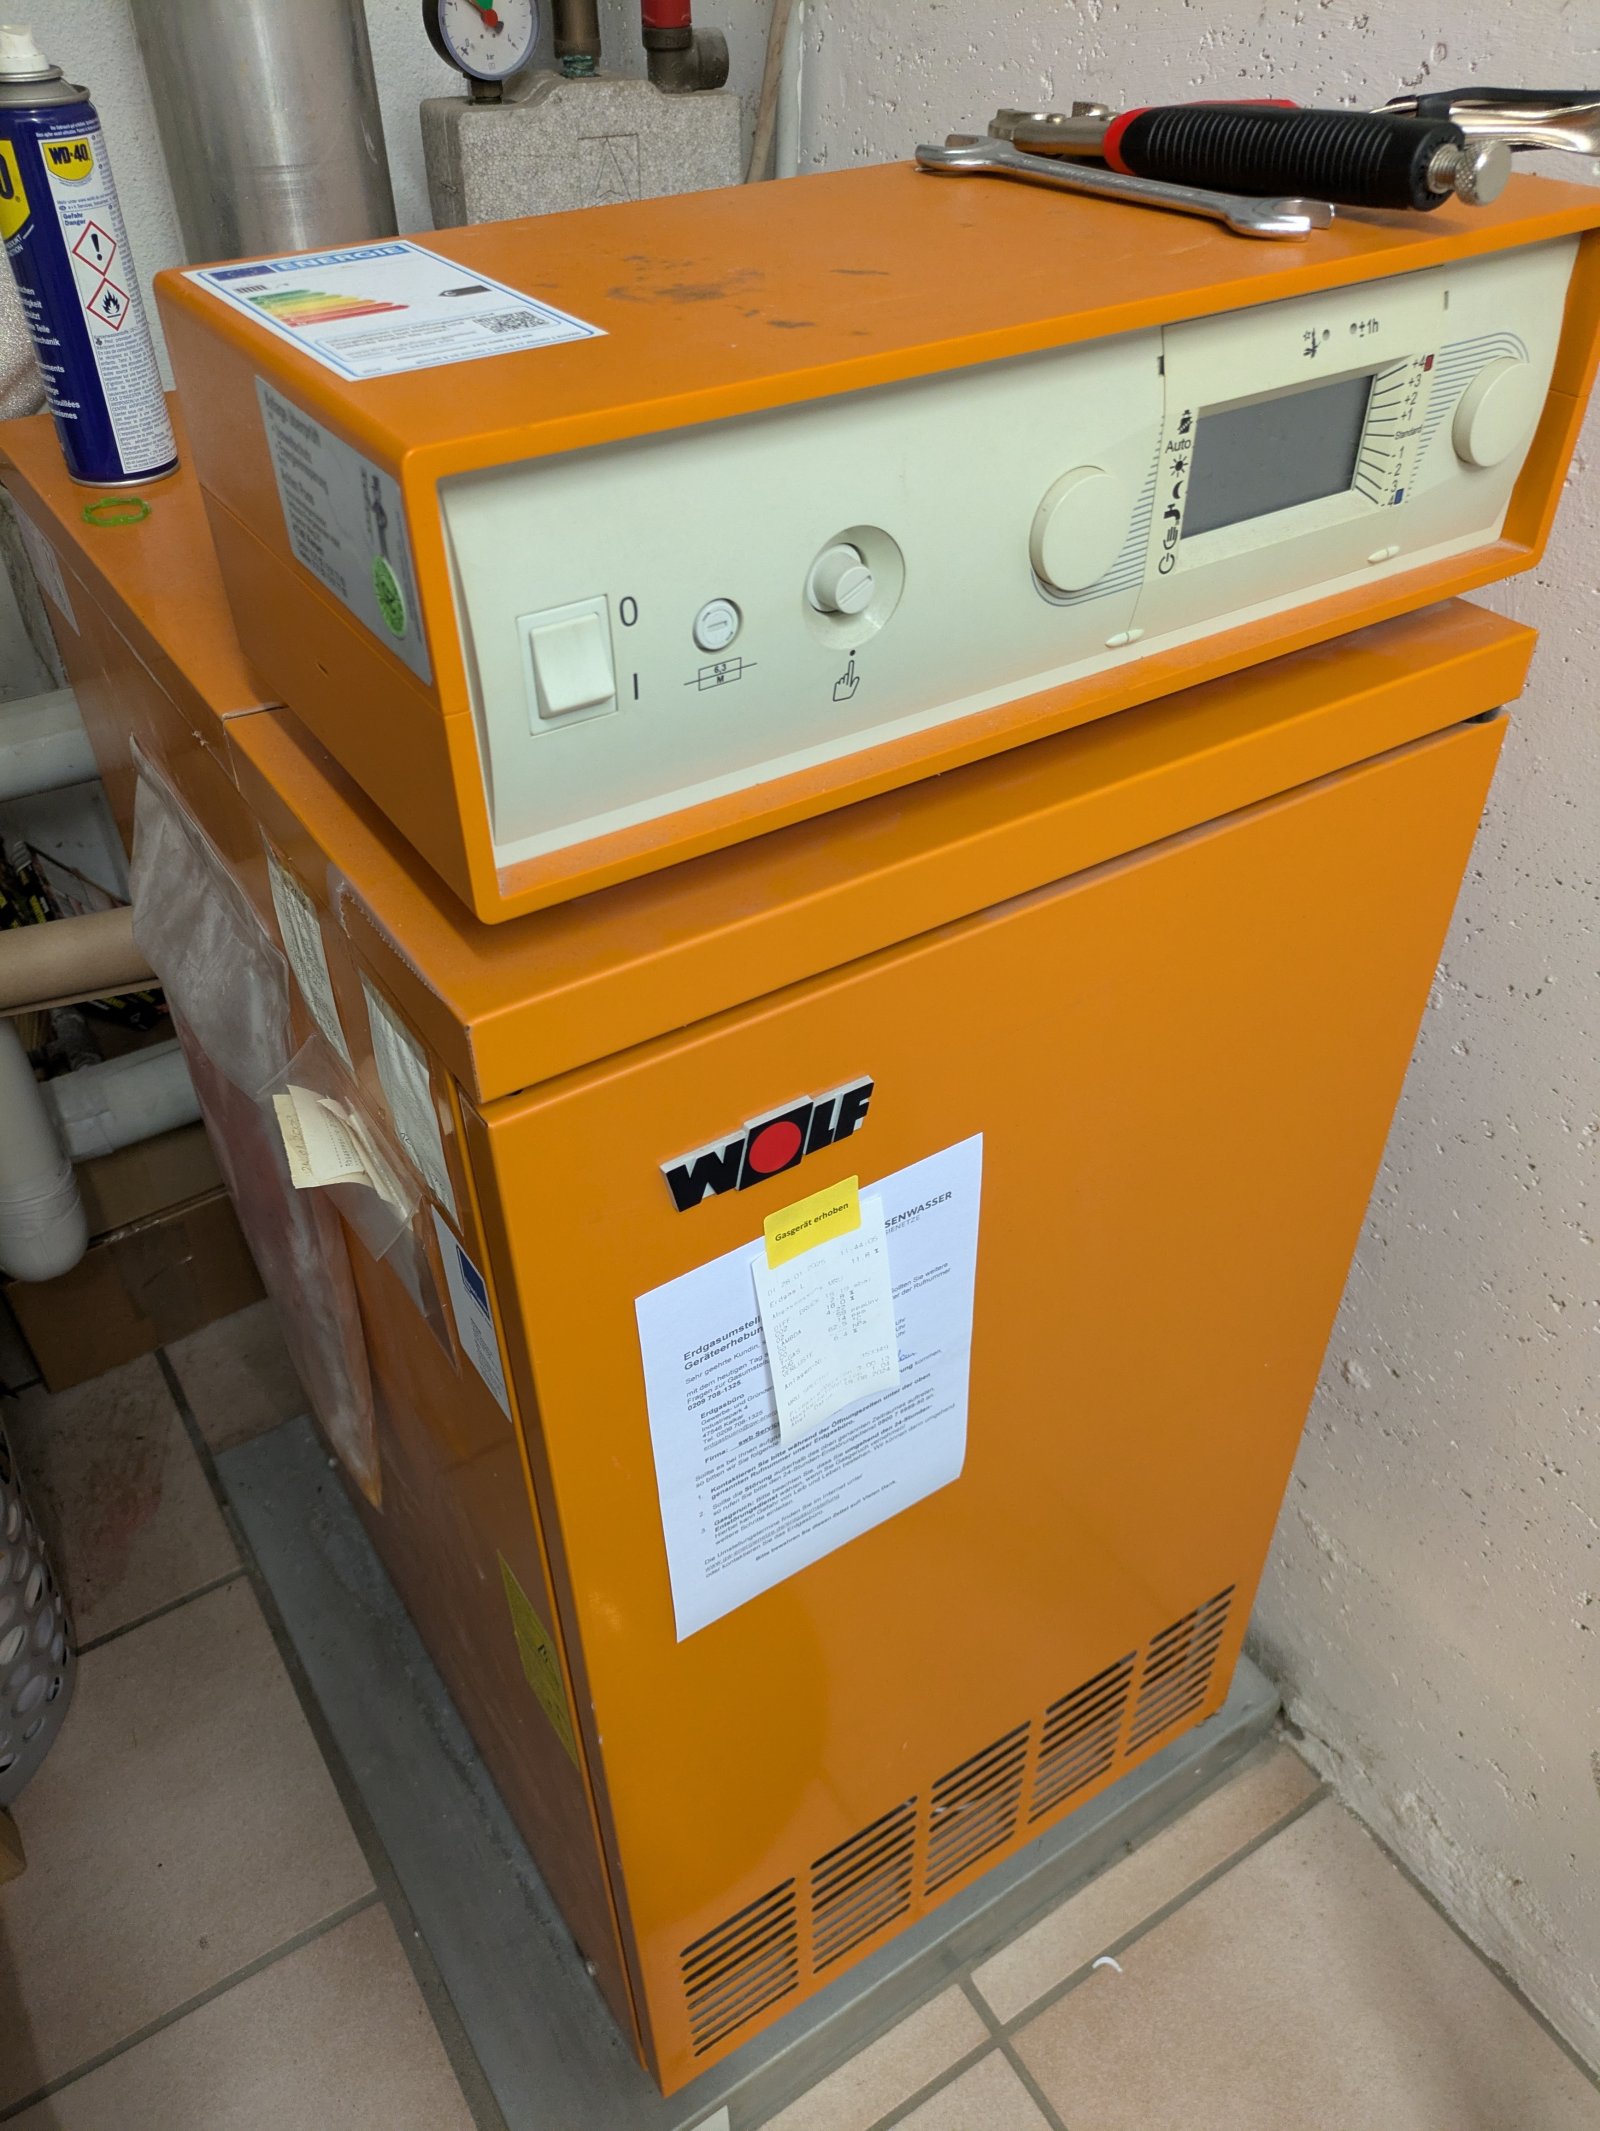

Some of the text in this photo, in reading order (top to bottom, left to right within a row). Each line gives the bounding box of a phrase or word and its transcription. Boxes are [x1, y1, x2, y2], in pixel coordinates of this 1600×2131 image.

[279, 246, 404, 271] ENERGIE
[1408, 373, 1422, 388] +3
[1404, 391, 1418, 406] +2
[1401, 408, 1413, 421] +1
[1165, 438, 1192, 454] Auto
[1394, 424, 1424, 441] Standard
[619, 596, 638, 627] 0
[717, 675, 725, 684] M
[664, 1080, 875, 1213] WOLF
[775, 1202, 849, 1242] Gasgerät erhoben
[884, 1190, 952, 1229] SENWASSER
[683, 1314, 760, 1361] Erdgasumstell
[686, 1387, 698, 1398] mit
[699, 1378, 715, 1391] dem
[717, 1362, 747, 1382] heutigen
[749, 1353, 762, 1365] Tag
[912, 1272, 923, 1283] Sie
[925, 1261, 948, 1277] weitere
[687, 1266, 950, 1405] Fragen zur der Rufnummer
[685, 1371, 702, 1385] Sehr
[704, 1356, 731, 1376] geehrte
[687, 1378, 741, 1411] 0209 708-1325
[700, 1391, 744, 1420] Erdgasbüro
[700, 1405, 732, 1426] Gewerbe-
[733, 1398, 746, 1409] und
[701, 1406, 742, 1433] Industriepark
[715, 1424, 732, 1438] 0209
[734, 1408, 763, 1428] 708-1325
[723, 1412, 743, 1427] Kalkar
[710, 1464, 756, 1493] Kontaktieren
[757, 1457, 768, 1468] Sie
[770, 1447, 786, 1461] bitte
[787, 1431, 817, 1452] während
[831, 1396, 881, 1429] Öffnungszeiten
[883, 1386, 900, 1400] unter
[914, 1371, 930, 1384] oben
[704, 1446, 728, 1464] Firma:
[738, 1444, 757, 1458] Ihnen
[705, 1468, 724, 1483] bitten
[711, 1475, 748, 1500] genannten
[750, 1452, 791, 1479] Rufnummer
[792, 1441, 811, 1456] unser
[744, 1472, 772, 1493] Störung
[714, 1492, 778, 1532] Entstörungsdienst
